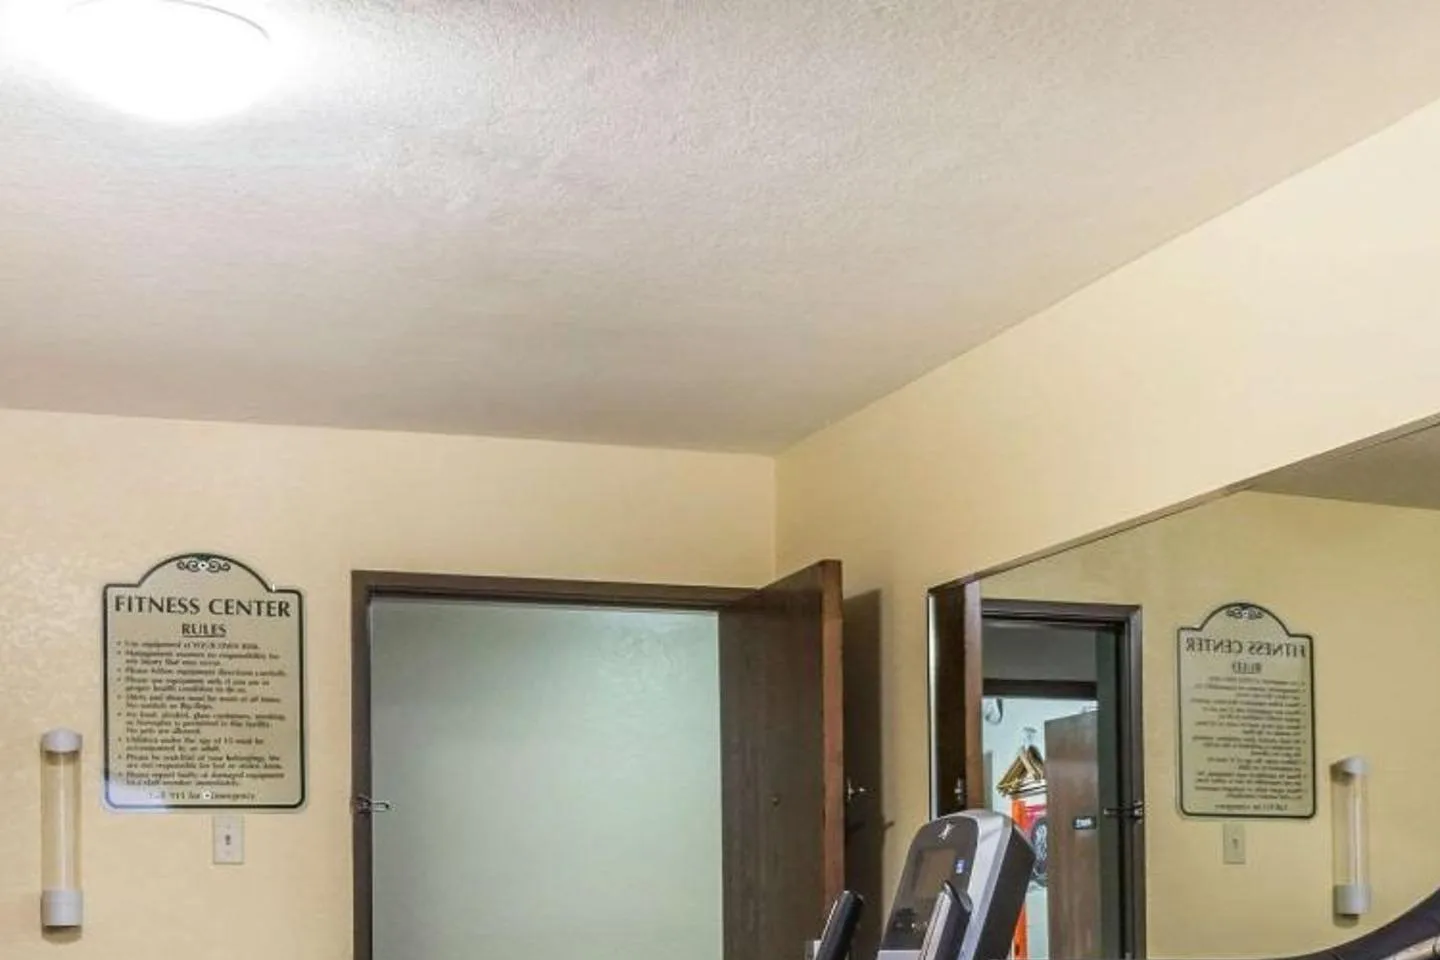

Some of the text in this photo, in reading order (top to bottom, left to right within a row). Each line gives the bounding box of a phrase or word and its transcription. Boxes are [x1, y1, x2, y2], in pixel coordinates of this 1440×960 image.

[114, 595, 291, 618] FITNESS CENTER
[181, 623, 227, 637] RULES
